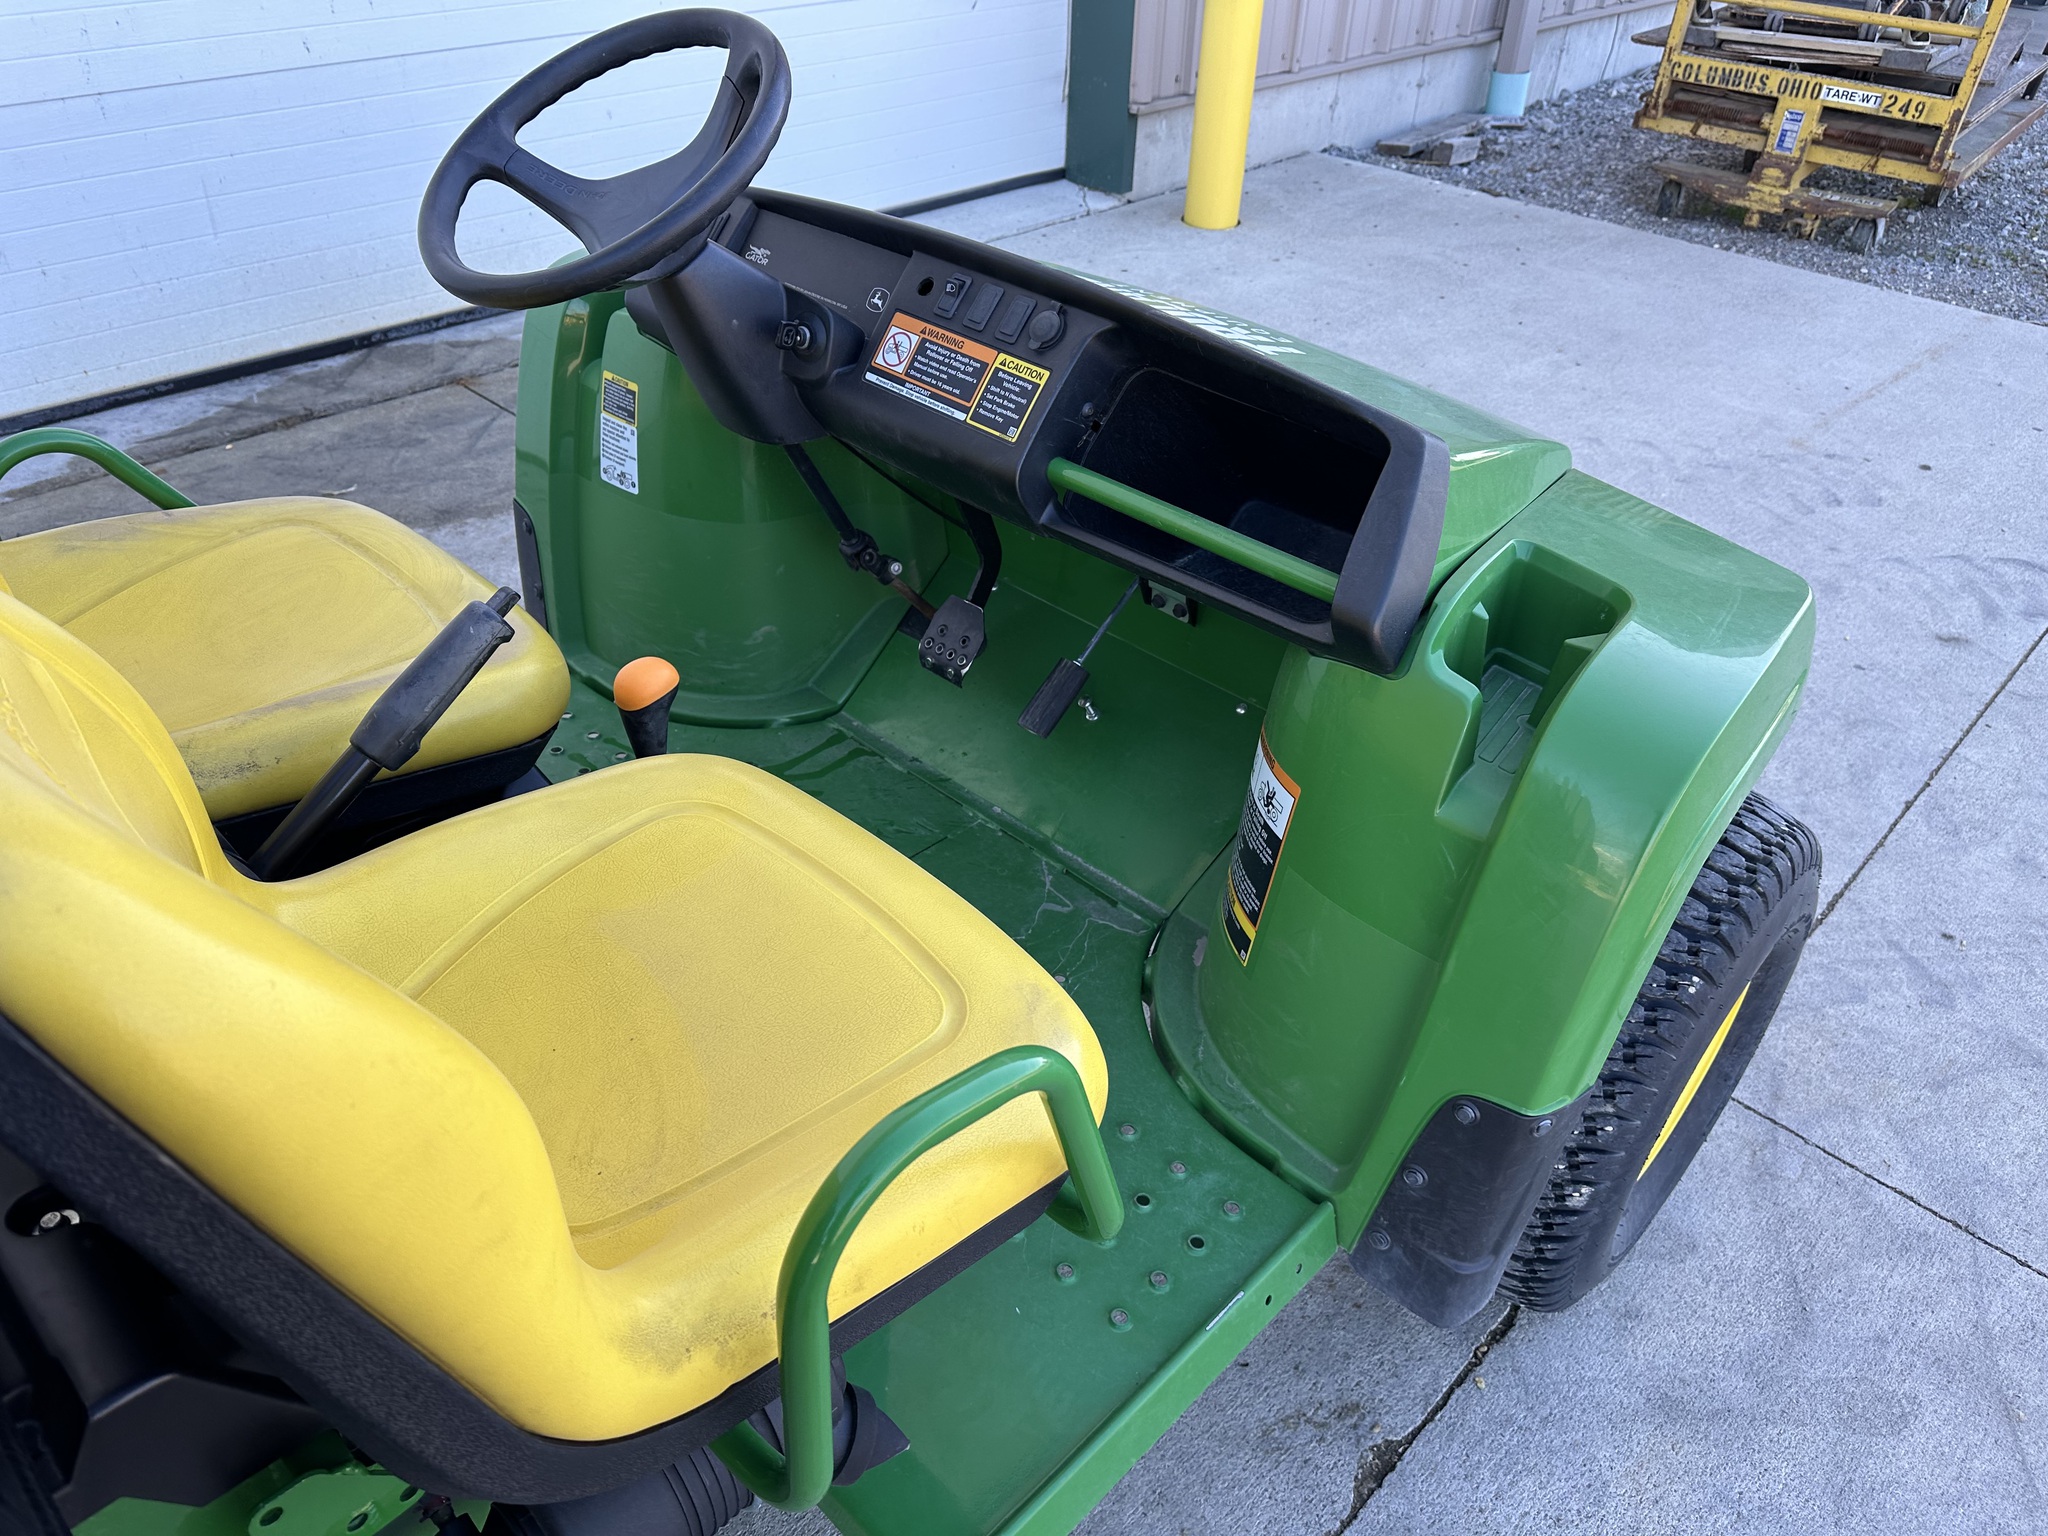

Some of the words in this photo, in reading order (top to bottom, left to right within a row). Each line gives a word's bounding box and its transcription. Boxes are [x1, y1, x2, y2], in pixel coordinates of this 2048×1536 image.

[1777, 81, 1823, 101] OHIO
[1882, 93, 1926, 120] 249
[526, 164, 580, 196] DEERE
[745, 251, 768, 266] GATOR
[927, 328, 965, 349] WARNING
[998, 371, 1014, 382] Before
[1014, 378, 1032, 390] Leaving
[1007, 360, 1044, 381] CAUTION
[995, 415, 1004, 423] Key
